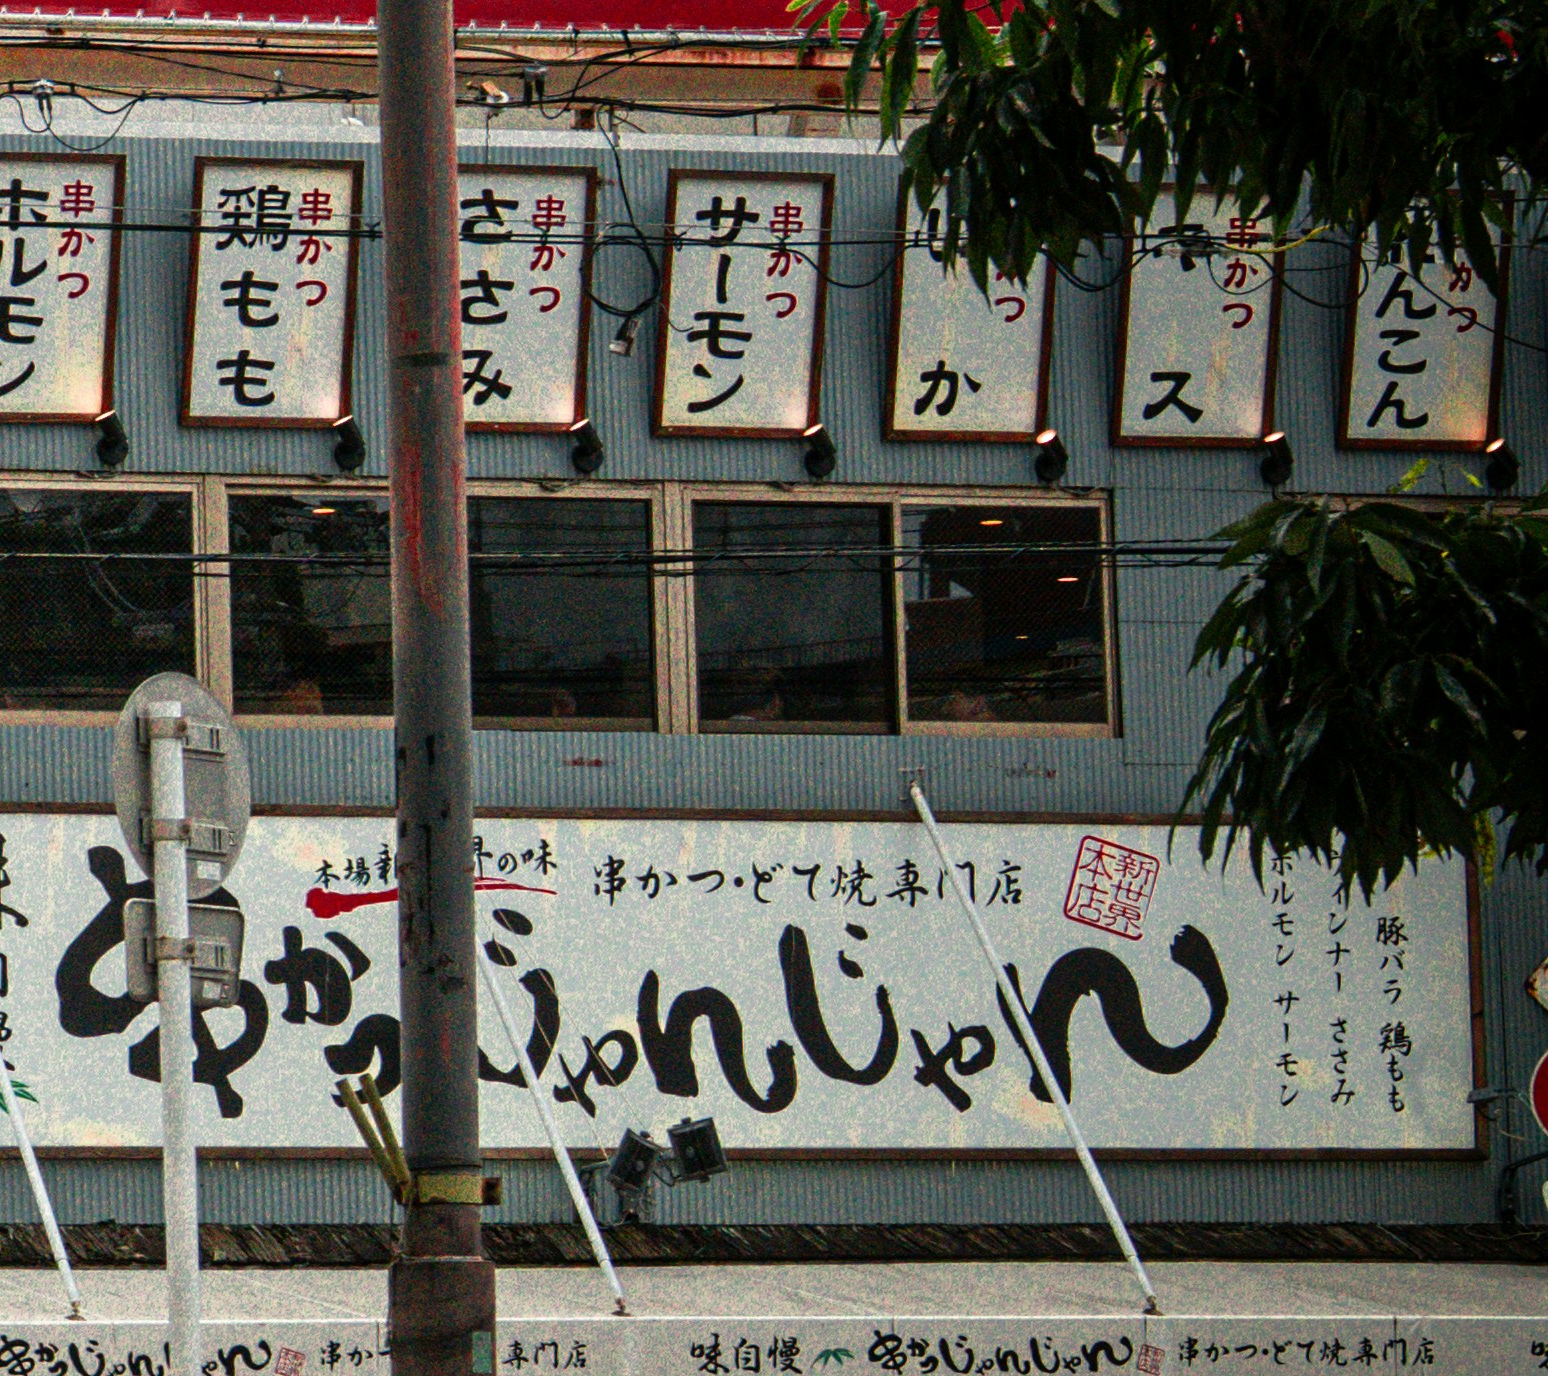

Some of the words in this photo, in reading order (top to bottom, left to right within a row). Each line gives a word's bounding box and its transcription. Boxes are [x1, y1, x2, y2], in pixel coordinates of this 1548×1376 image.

[56, 179, 97, 300] 串かつ
[295, 186, 334, 308] 串かつ
[529, 192, 569, 314] 串かつ
[765, 200, 805, 320] 串かつ
[214, 183, 293, 409] 鶏もも
[459, 187, 519, 408] ささみ
[686, 194, 759, 415] サーモン
[315, 837, 556, 888] 本場新の味
[592, 857, 1023, 908] 串かつ・どて焼専門店
[1071, 844, 1113, 924] 本店
[1103, 853, 1155, 933] 新世界
[1271, 855, 1295, 966] ホルモン
[1376, 916, 1409, 1005] 豚バラ
[1273, 990, 1300, 1107] サーモン
[1329, 1017, 1355, 1106] ささみ
[1380, 1021, 1412, 1113] 鶏もも
[503, 1340, 588, 1370] 専門店
[689, 1333, 803, 1375] 味自慢
[868, 1330, 1134, 1376] 串かつじゃんじゃん
[1177, 1337, 1436, 1367] 串かつ・どて焼専門店
